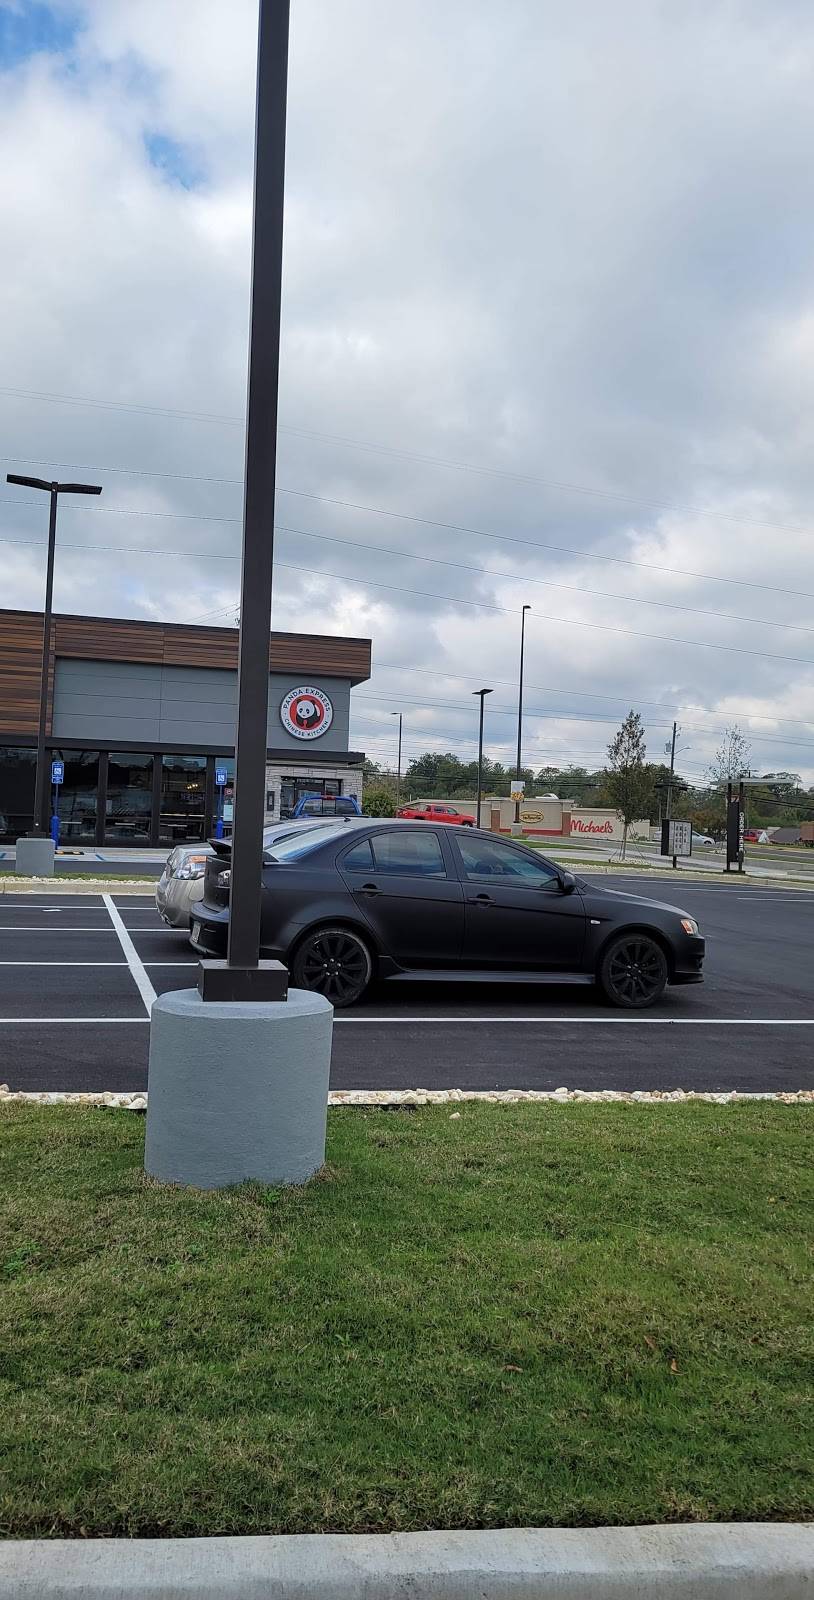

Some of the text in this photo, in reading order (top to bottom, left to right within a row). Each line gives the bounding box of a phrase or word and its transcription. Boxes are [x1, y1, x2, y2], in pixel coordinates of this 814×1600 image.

[283, 688, 331, 712] PANDA EXPRESS
[284, 719, 329, 737] CHINESE KITCHEN
